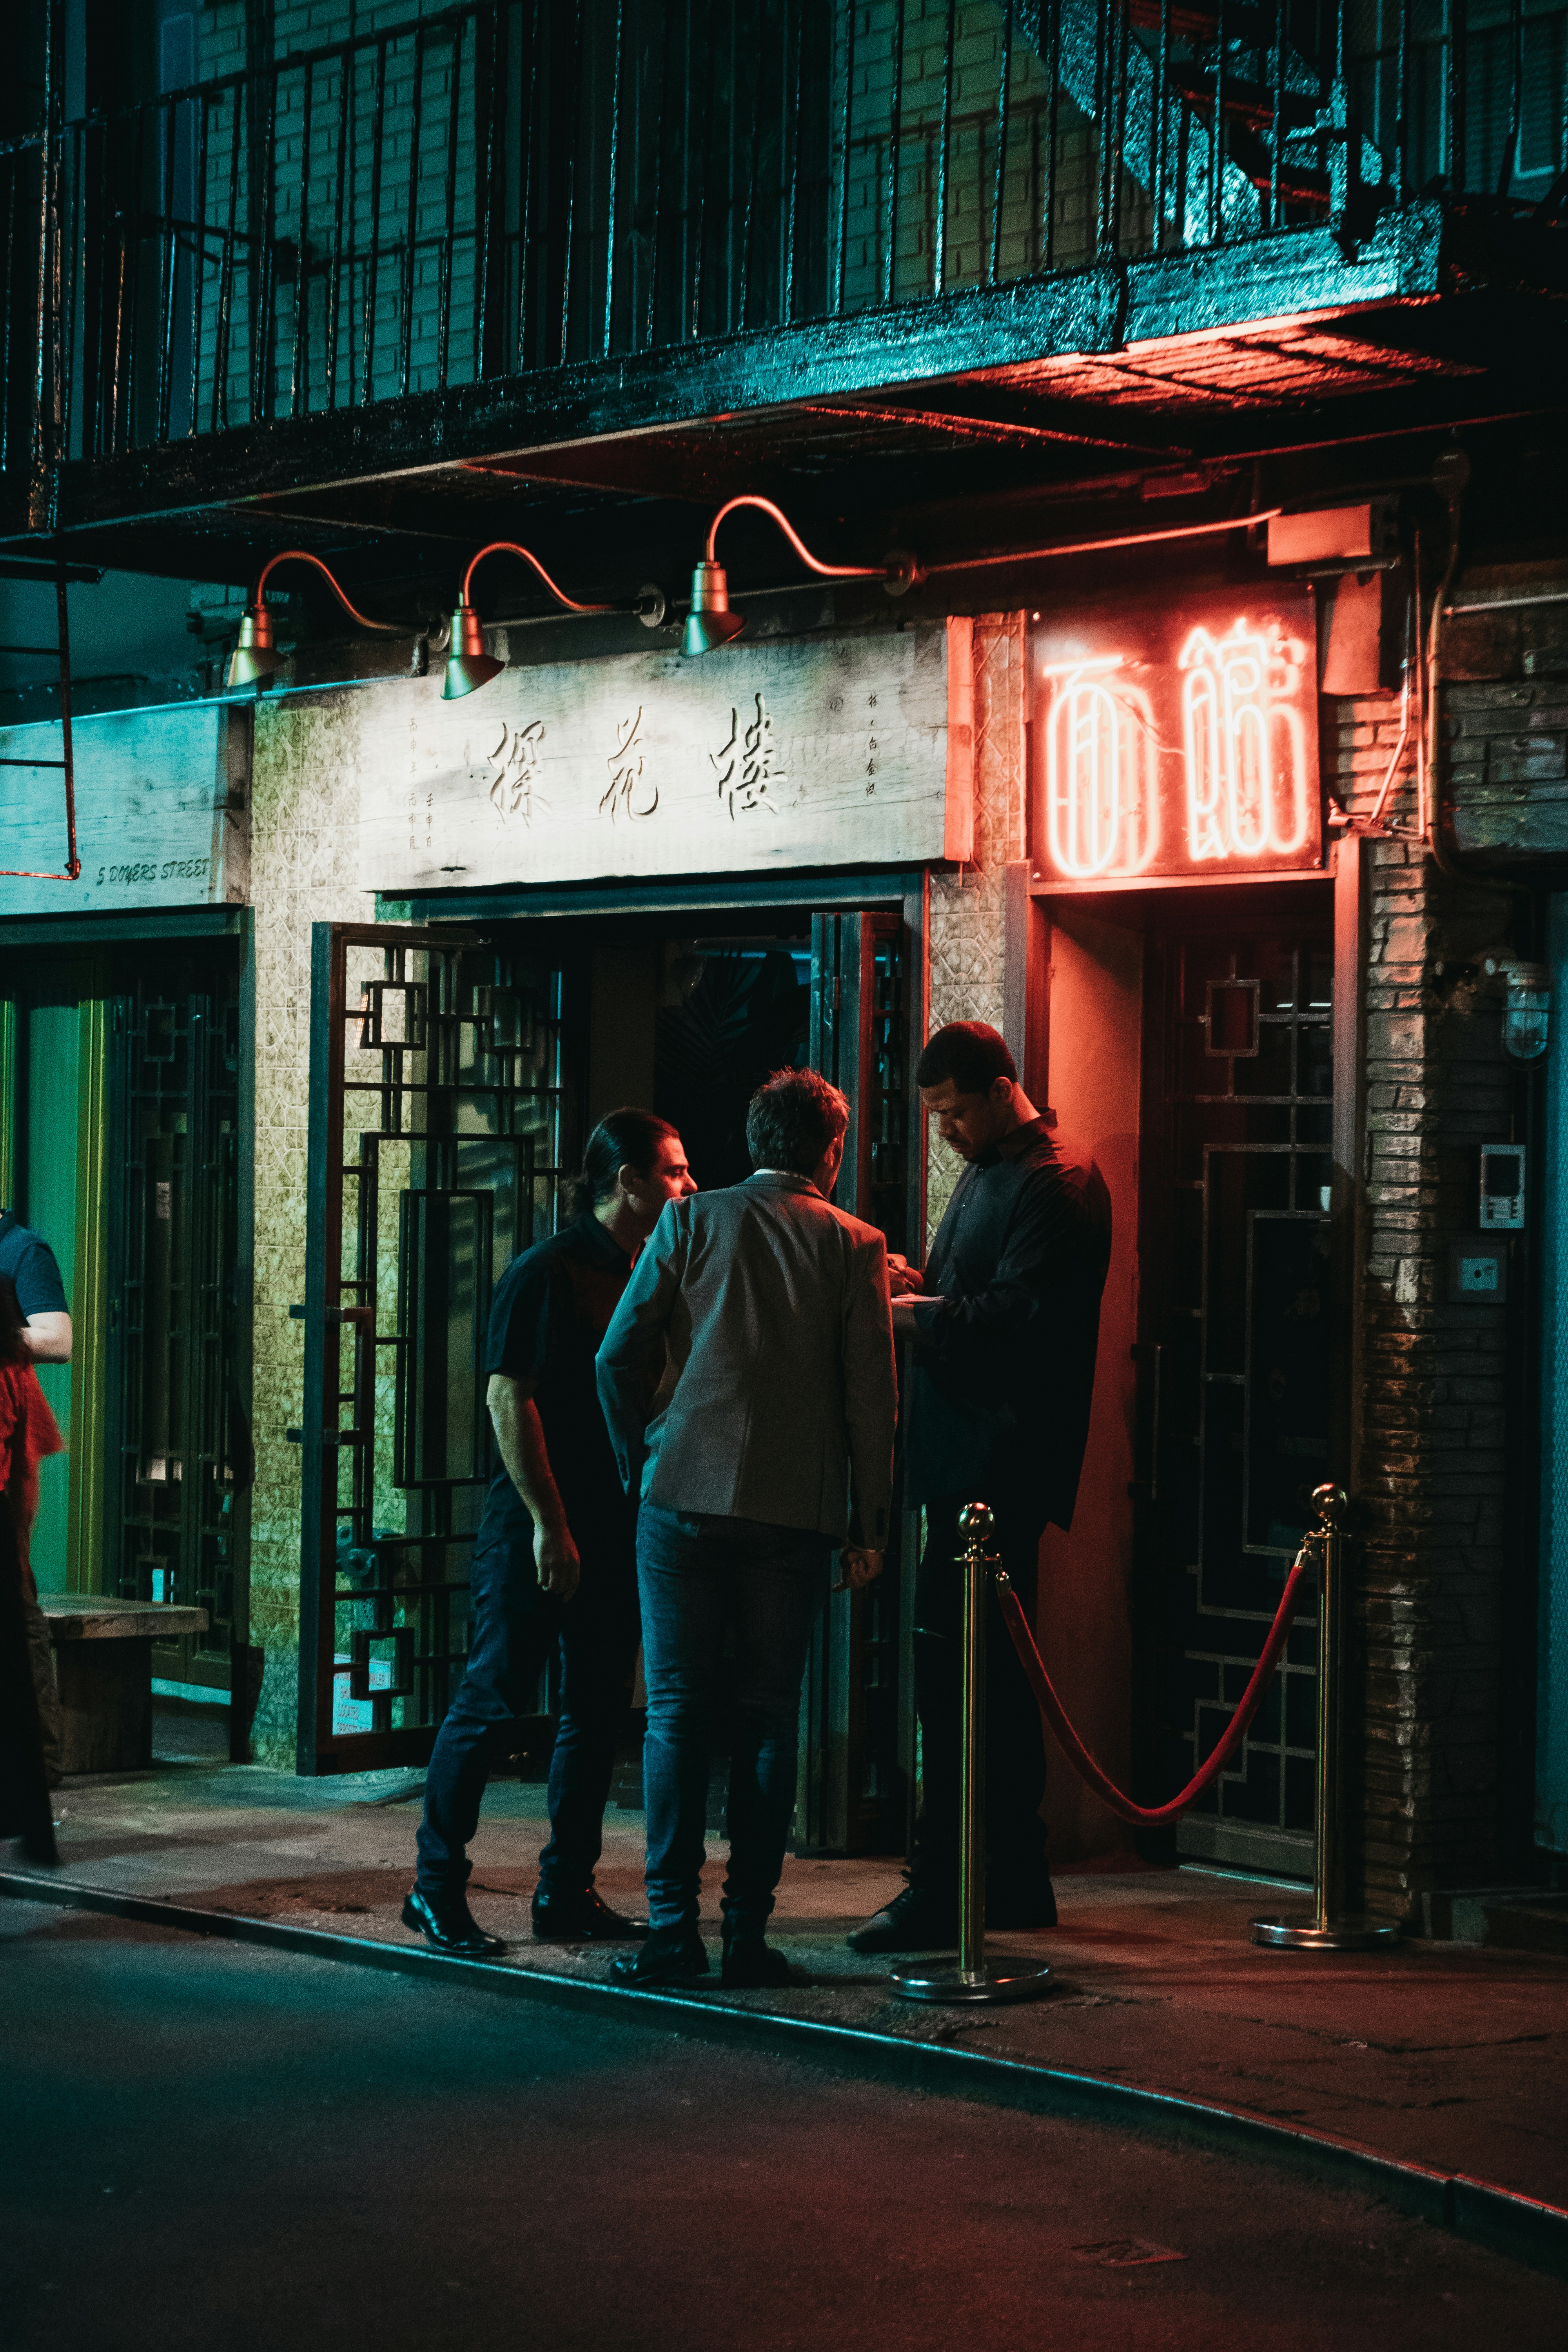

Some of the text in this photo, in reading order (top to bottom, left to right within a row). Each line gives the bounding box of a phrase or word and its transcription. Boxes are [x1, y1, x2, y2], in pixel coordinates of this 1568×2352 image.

[96, 858, 210, 886] 5 DOYERS STREET
